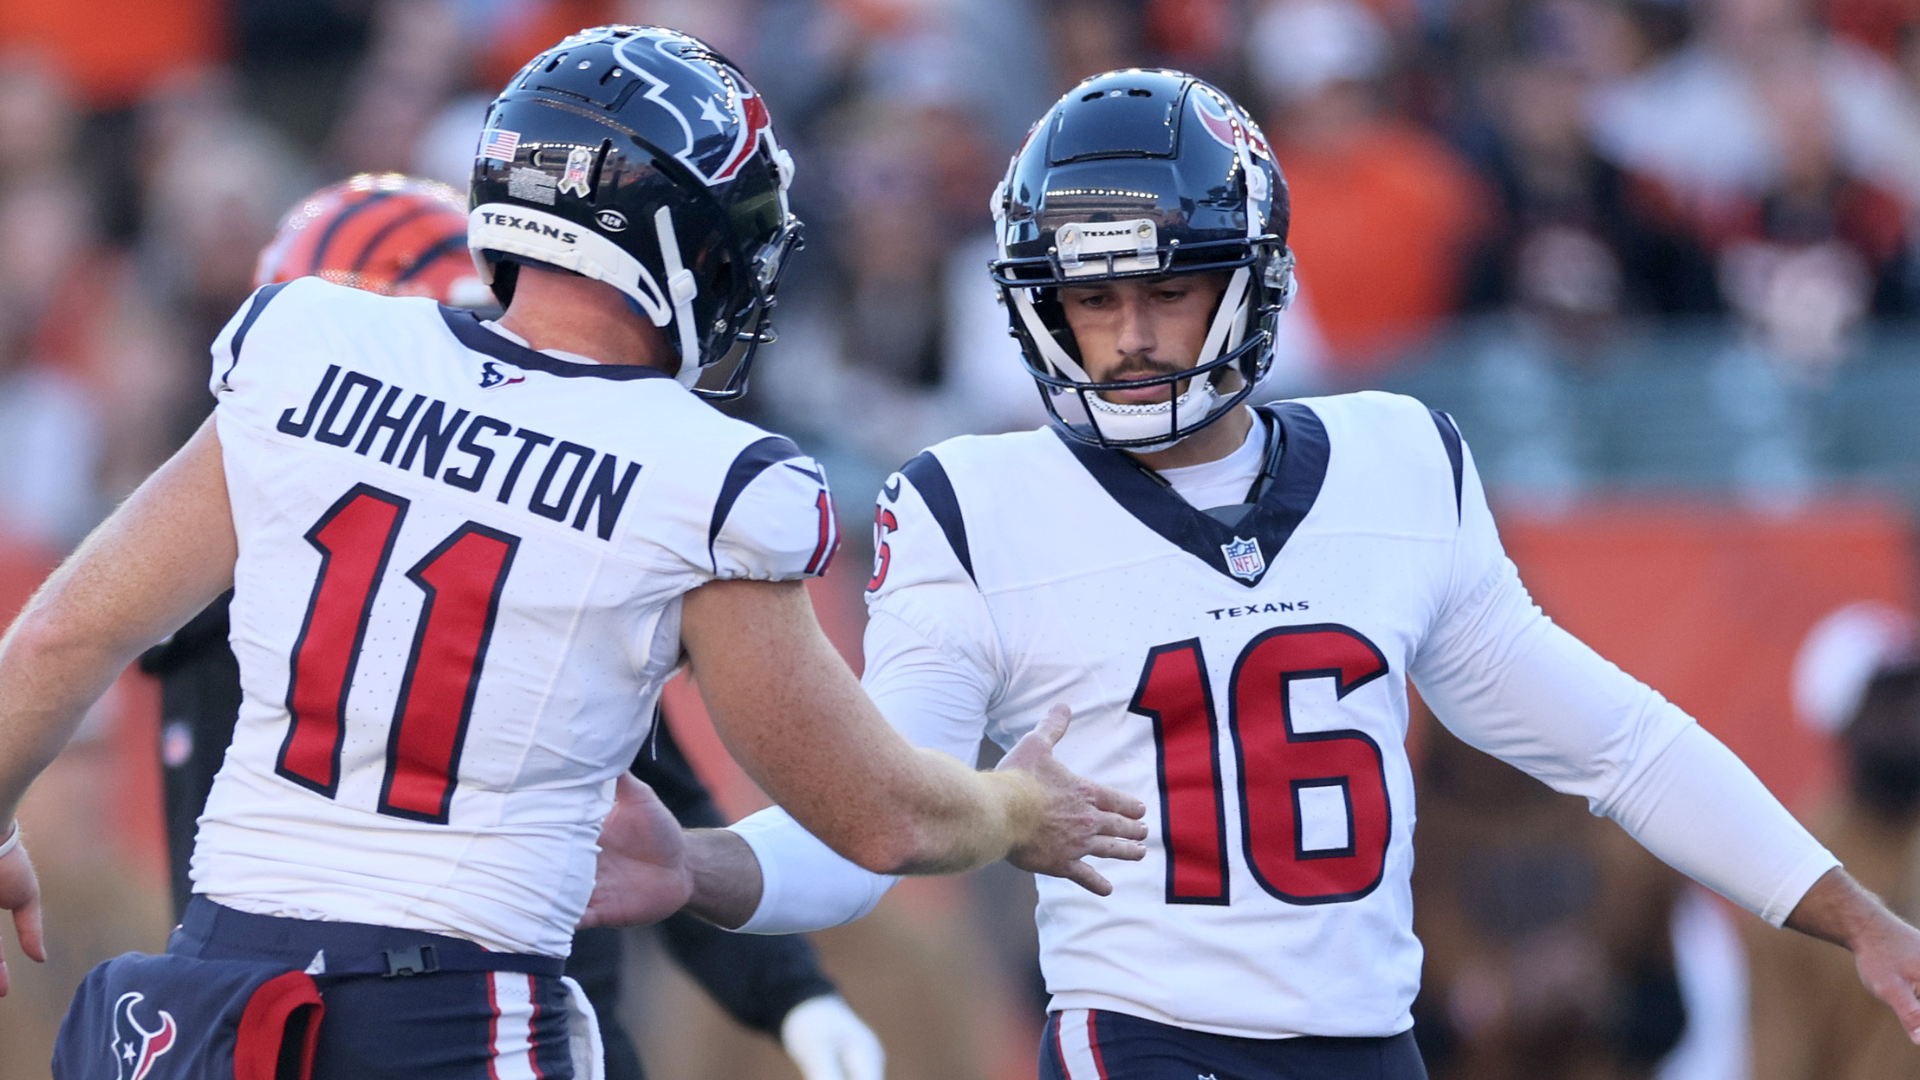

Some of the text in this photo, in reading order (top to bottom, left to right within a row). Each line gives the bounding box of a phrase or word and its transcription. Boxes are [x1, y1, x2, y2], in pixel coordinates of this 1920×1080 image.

[482, 212, 579, 245] TEXANS
[1081, 229, 1132, 237] TEXANS
[276, 364, 643, 542] JOHNSTON
[1233, 554, 1260, 573] NFL
[1205, 600, 1310, 620] TEXANS
[274, 481, 522, 825] 11
[1127, 622, 1392, 906] 16
